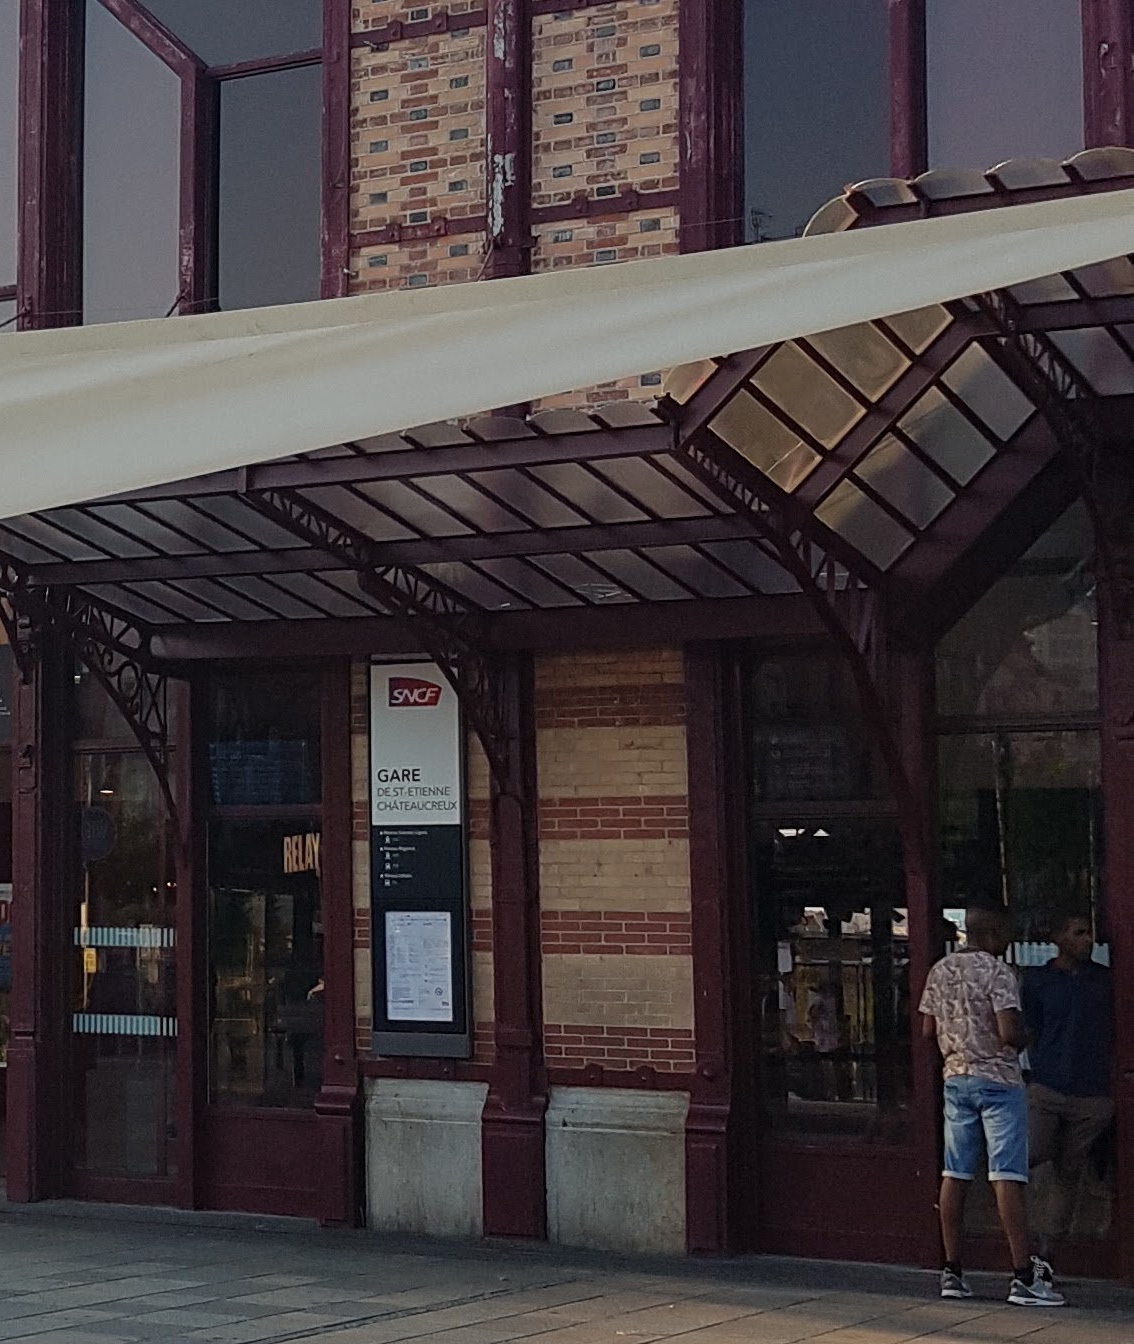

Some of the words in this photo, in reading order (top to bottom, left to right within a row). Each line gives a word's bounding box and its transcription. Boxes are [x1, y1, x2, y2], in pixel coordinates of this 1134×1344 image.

[391, 688, 438, 704] SNCF
[377, 768, 421, 783] GARE
[377, 787, 391, 797] DE
[283, 833, 320, 873] RELAY
